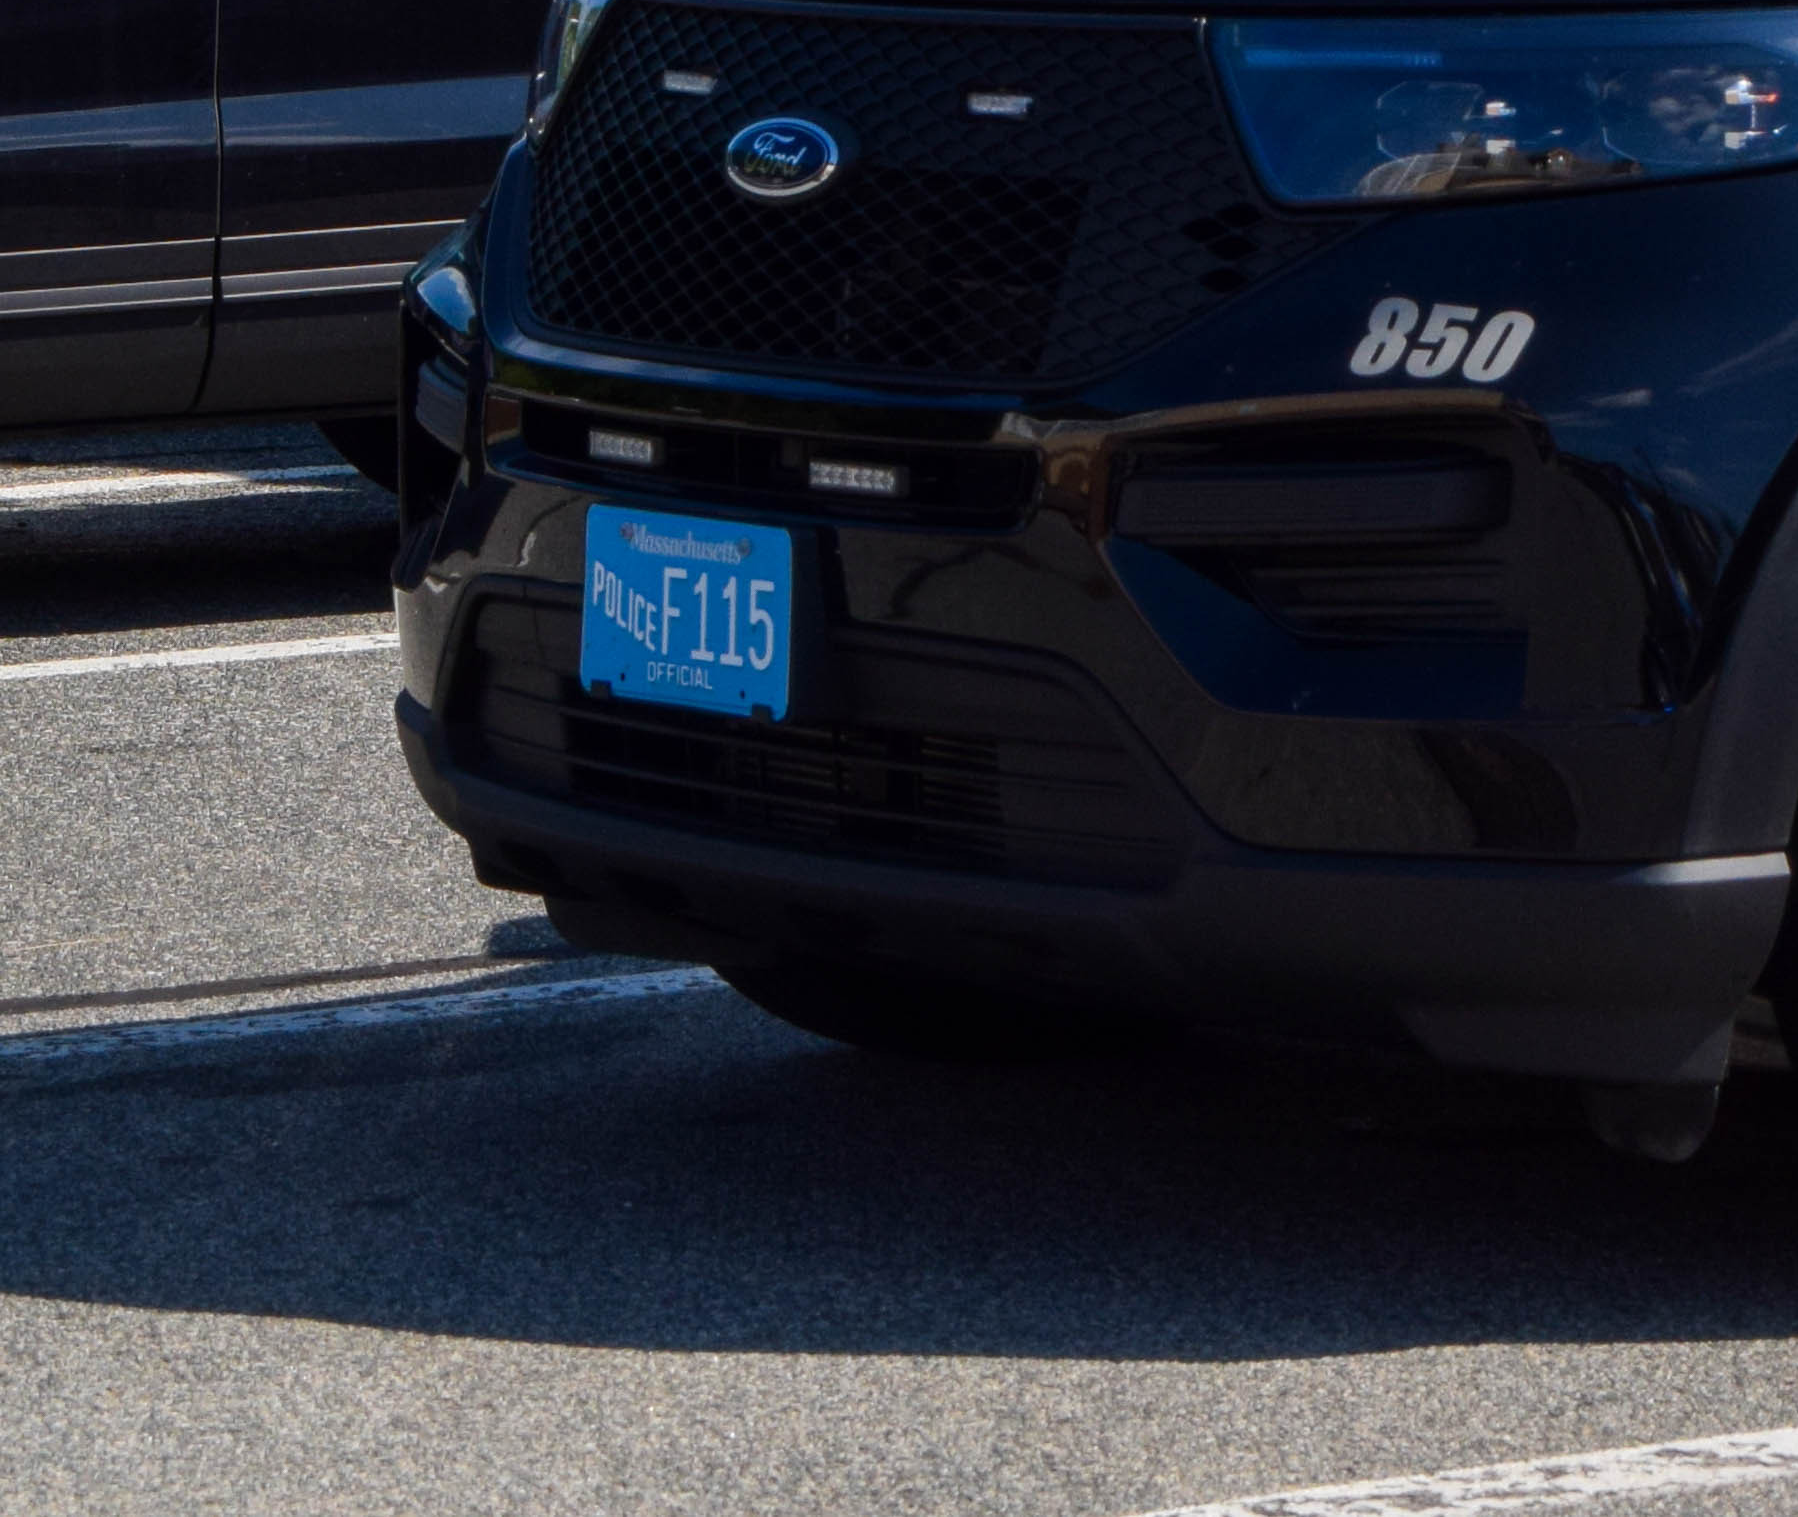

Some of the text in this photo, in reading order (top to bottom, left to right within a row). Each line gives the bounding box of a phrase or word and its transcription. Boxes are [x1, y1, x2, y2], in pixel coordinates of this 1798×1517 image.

[752, 132, 807, 166] Ford
[1350, 297, 1535, 382] 850
[630, 522, 742, 565] Massachusetts
[592, 560, 775, 671] POLICE F115
[647, 661, 713, 690] OFFICIAL
